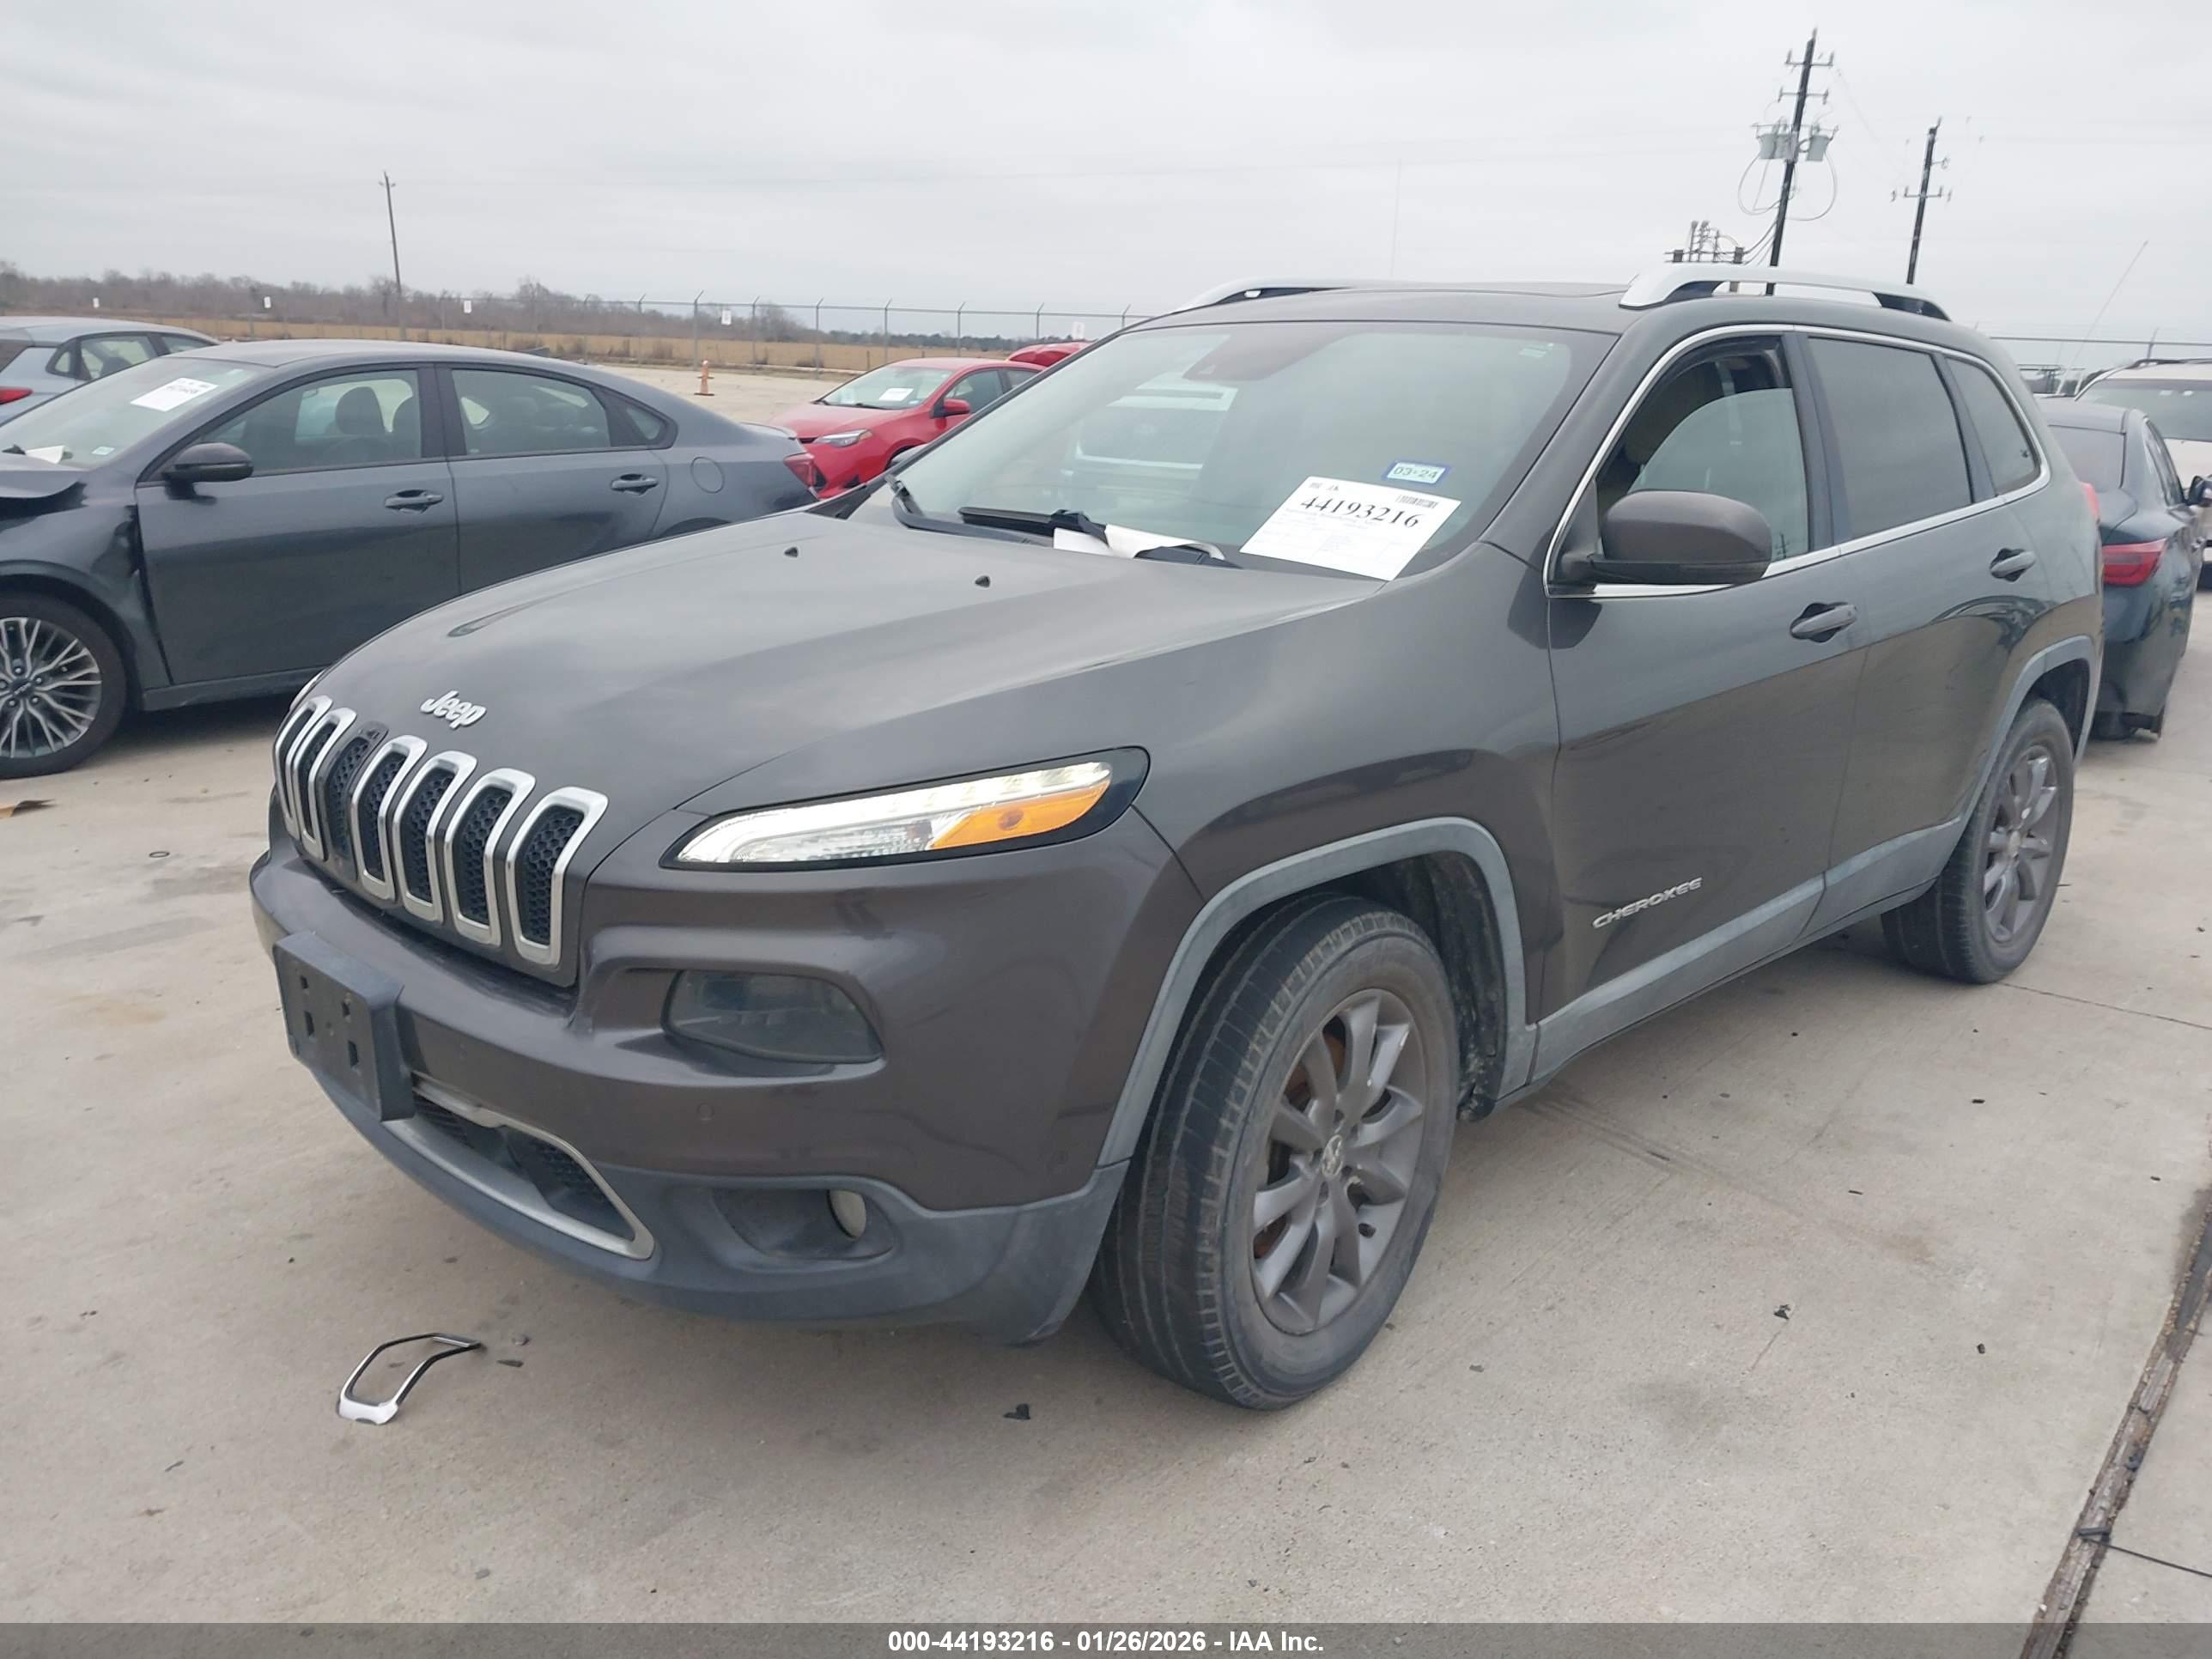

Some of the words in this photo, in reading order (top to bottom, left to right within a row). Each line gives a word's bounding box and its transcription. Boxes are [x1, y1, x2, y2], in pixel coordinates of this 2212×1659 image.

[1301, 495, 1422, 527] 44193216
[420, 690, 487, 728] Jeep
[1592, 877, 1703, 929] CHEROKEE
